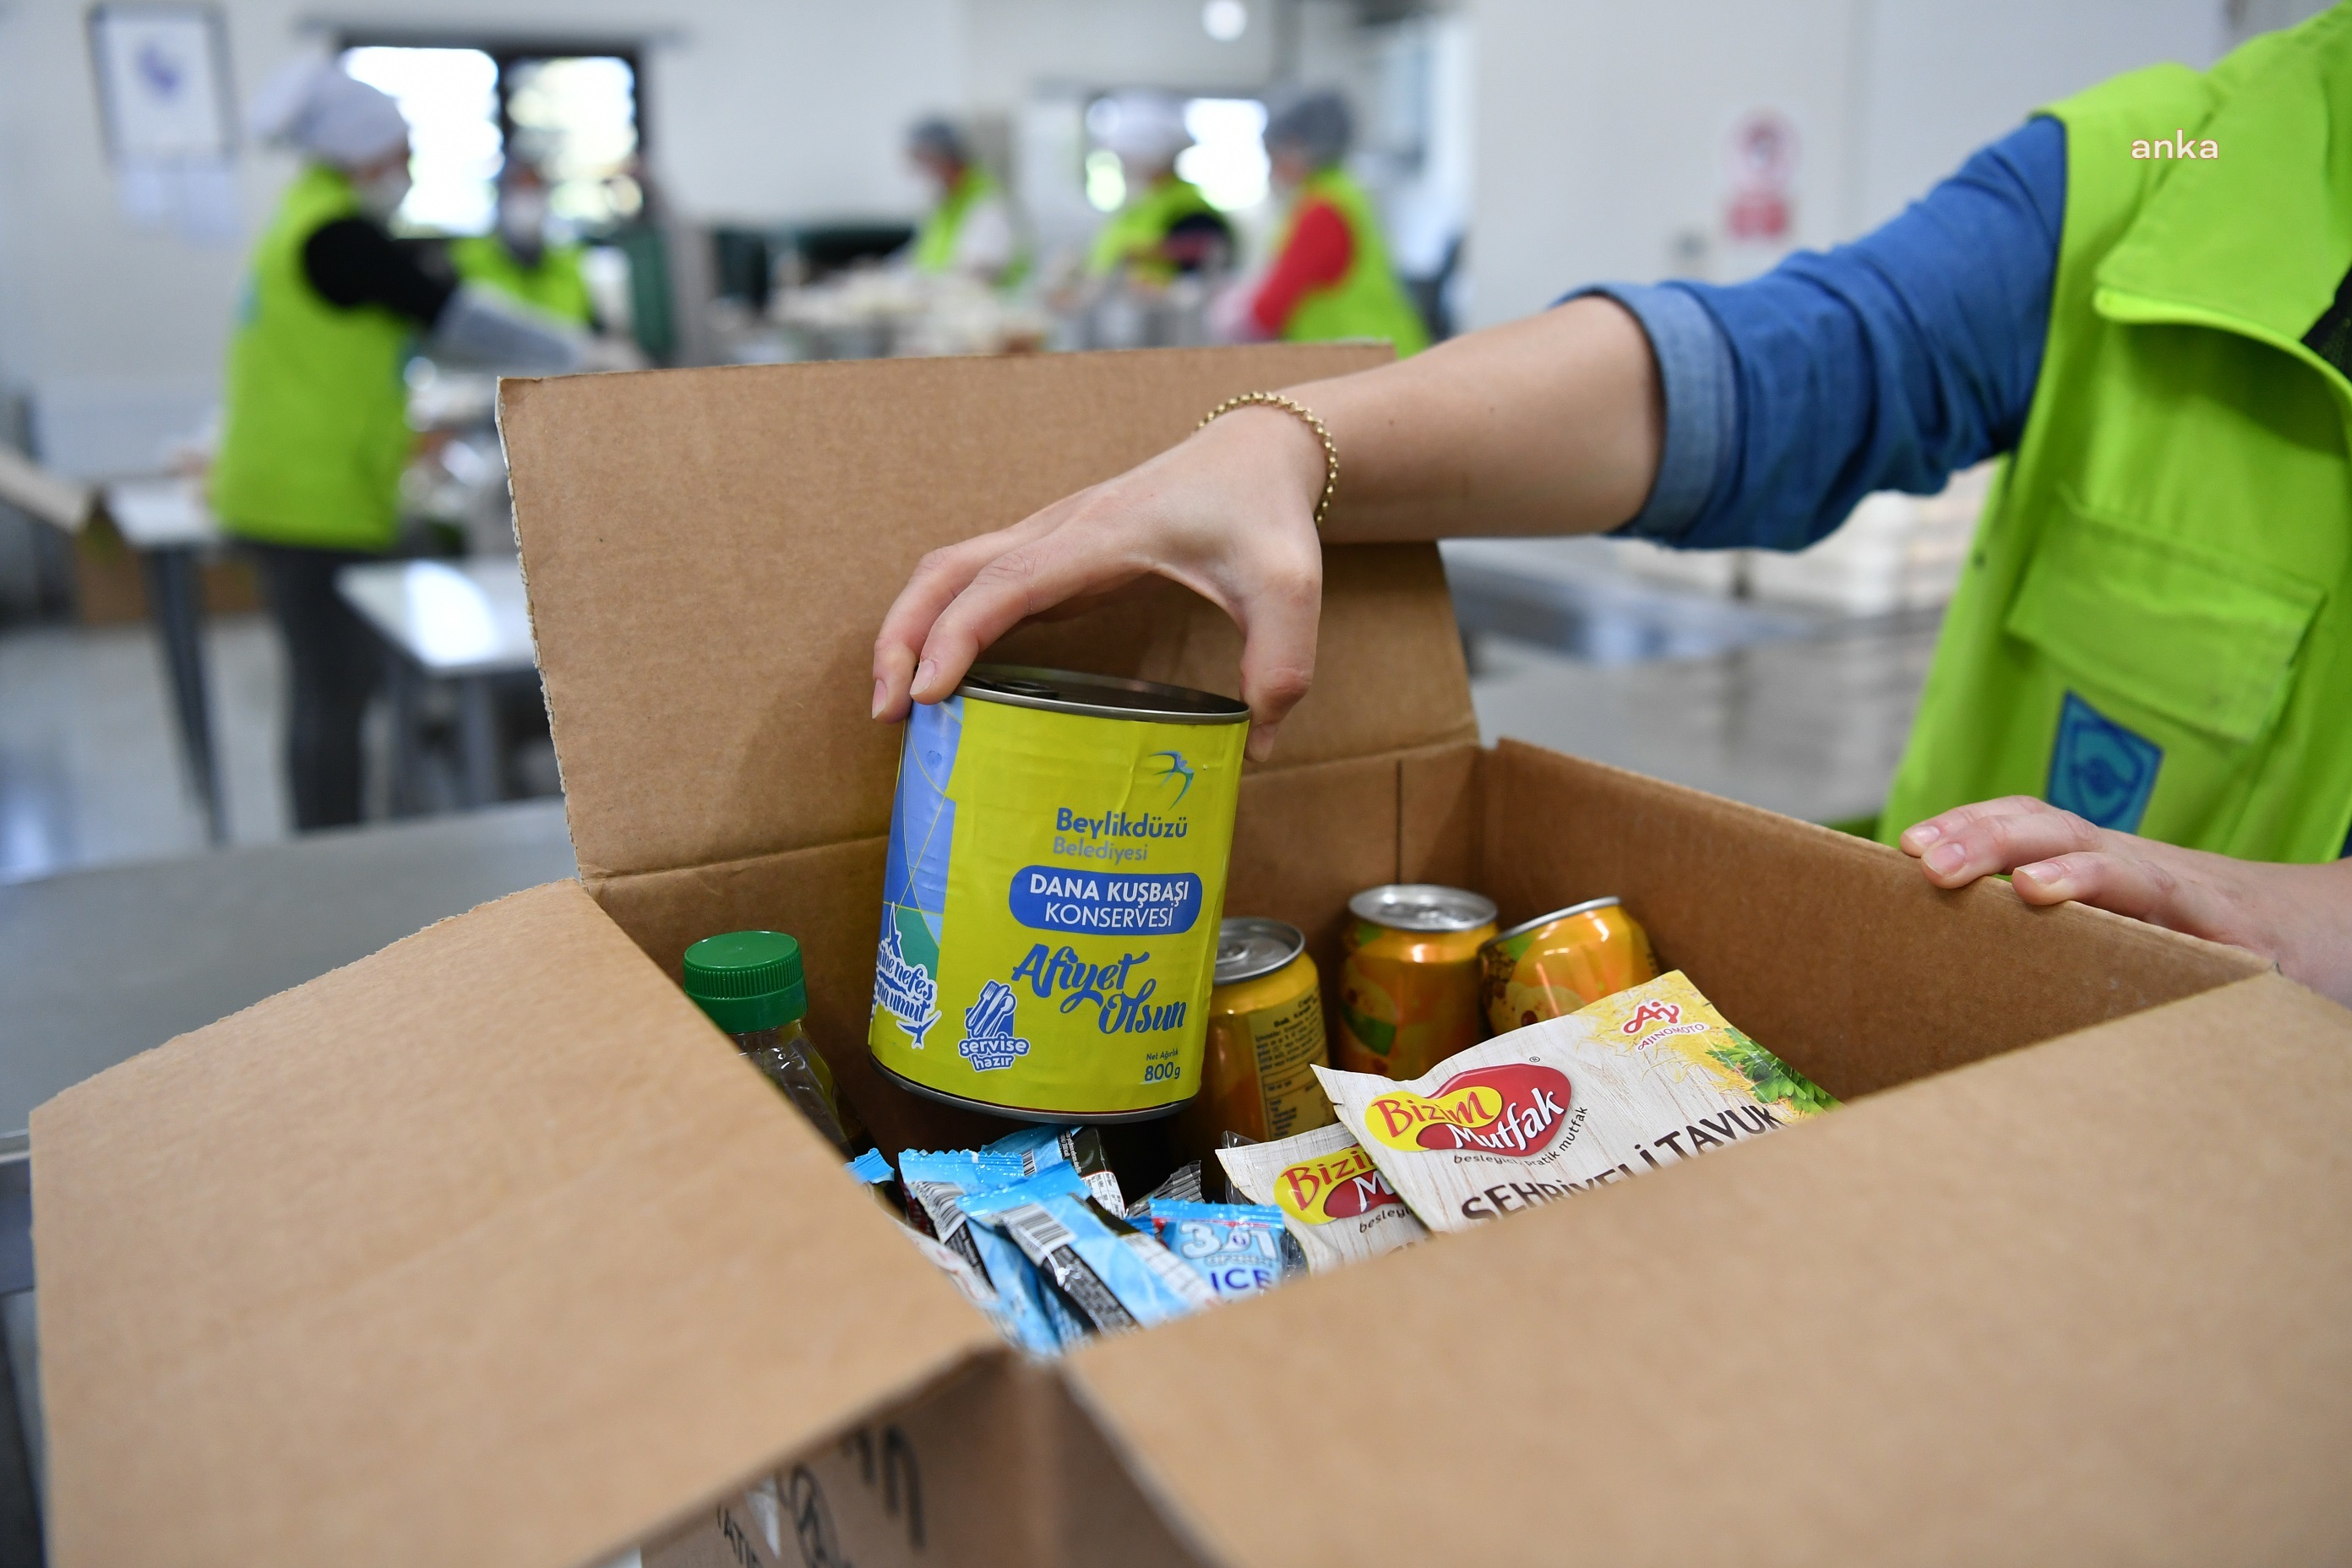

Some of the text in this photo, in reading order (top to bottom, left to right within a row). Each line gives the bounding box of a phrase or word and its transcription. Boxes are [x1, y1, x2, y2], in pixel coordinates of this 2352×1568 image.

[1056, 808, 1188, 839] Beylikdüzü
[1054, 836, 1148, 865] Belediyesi
[1030, 874, 1189, 908] DANA KUŞBAŞI
[1045, 902, 1174, 928] KONSERVESİ
[895, 961, 934, 1000] nefes
[1011, 944, 1150, 1014] Afiyet
[890, 992, 931, 1022] umut
[1098, 978, 1187, 1034] Olsun
[961, 1036, 1029, 1054] servise
[1638, 1024, 1705, 1051] AJINOMOTO
[972, 1055, 1013, 1070] hazır
[1145, 1061, 1180, 1082] 800g
[1146, 1052, 1158, 1060] Net
[1371, 1092, 1494, 1138] Bizim
[1446, 1087, 1564, 1151] Mutfak
[1524, 1151, 1560, 1167] pratik
[1559, 1106, 1588, 1152] mutfak
[1353, 1168, 1395, 1212] M
